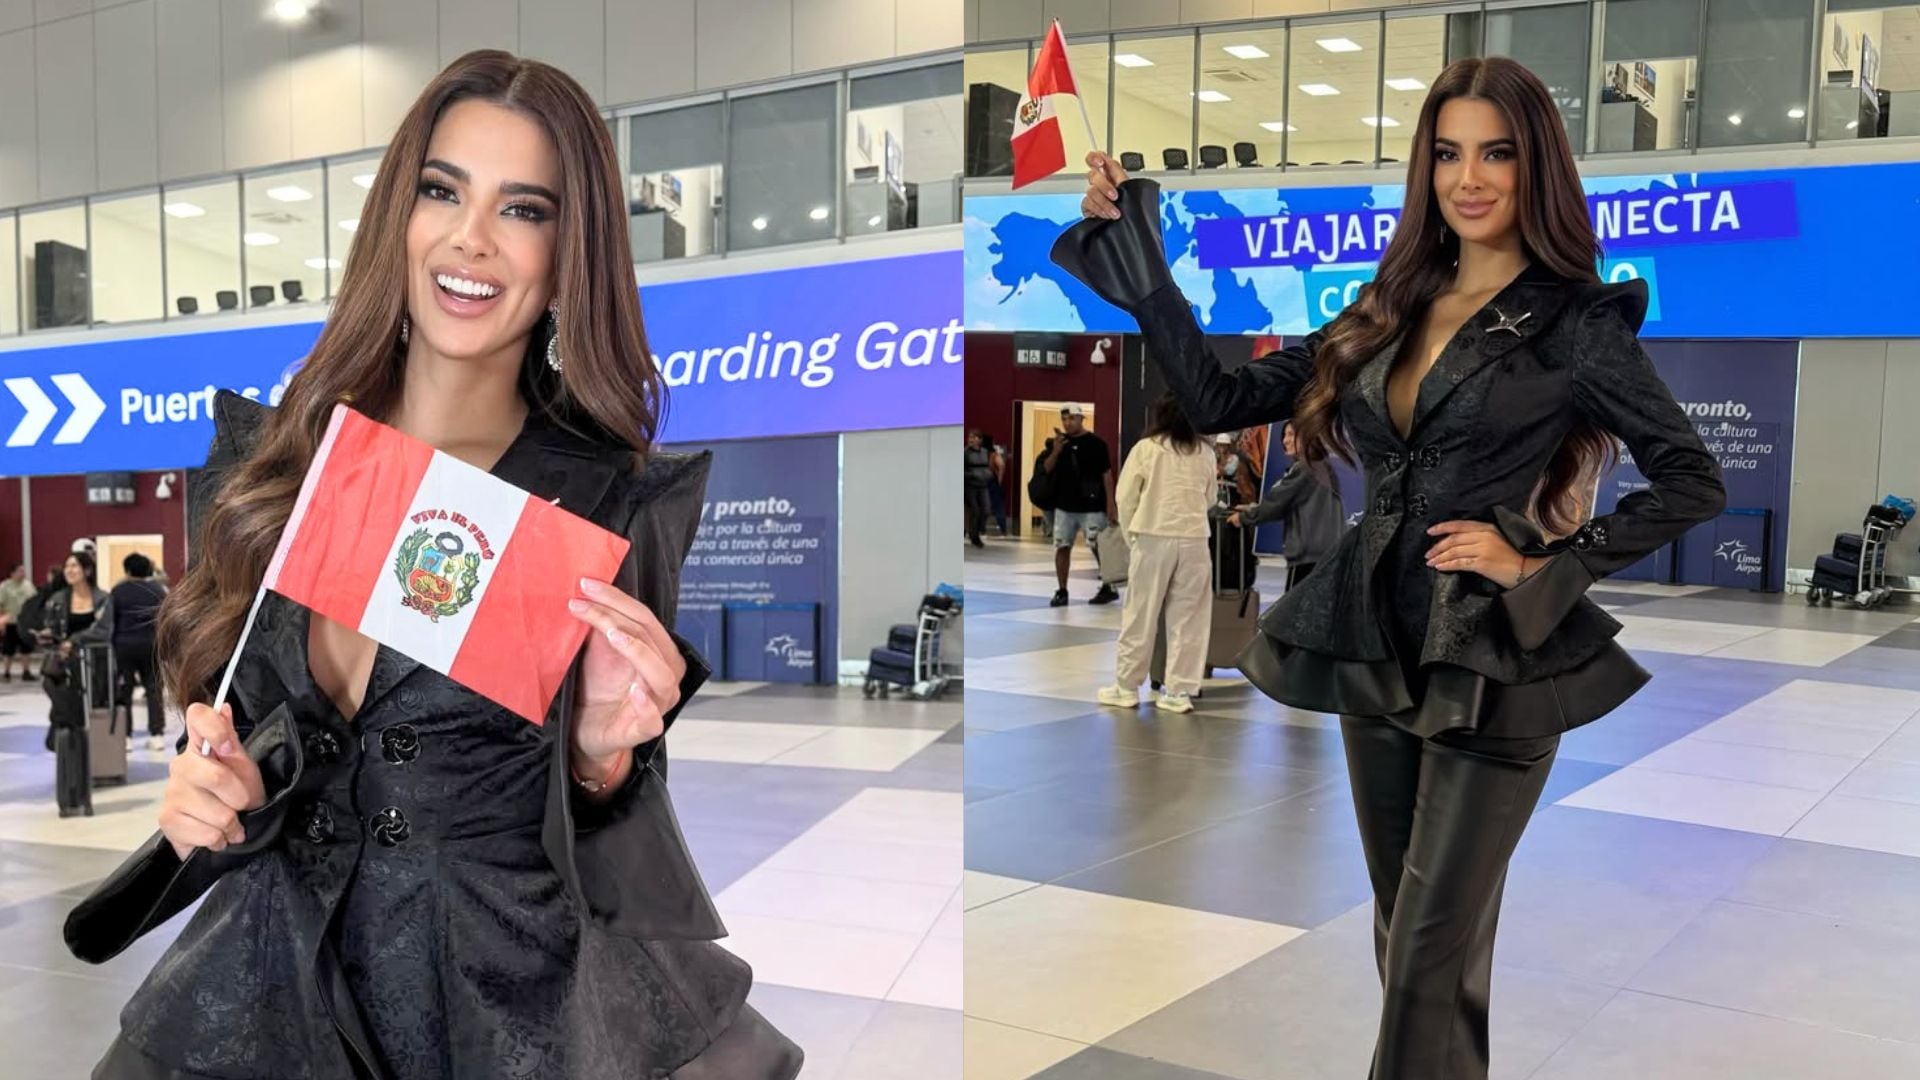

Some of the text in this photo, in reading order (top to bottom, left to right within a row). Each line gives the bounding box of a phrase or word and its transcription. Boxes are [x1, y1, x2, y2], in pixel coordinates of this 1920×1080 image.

[1595, 190, 1741, 240] NECTA
[1242, 213, 1397, 263] VIAJAR
[649, 330, 842, 388] arding
[120, 383, 262, 426] Puert
[1727, 440, 1746, 454] de
[1746, 445, 1773, 454] una
[1721, 456, 1758, 469] única
[410, 508, 449, 525] VIVA
[713, 495, 797, 521] pronto,
[715, 524, 740, 539] por
[740, 522, 754, 535] la
[718, 540, 730, 551] a
[731, 536, 769, 551] través
[771, 535, 790, 549] de
[790, 538, 820, 549] una
[686, 552, 804, 566] ta comercial única
[1736, 553, 1761, 564] Lima
